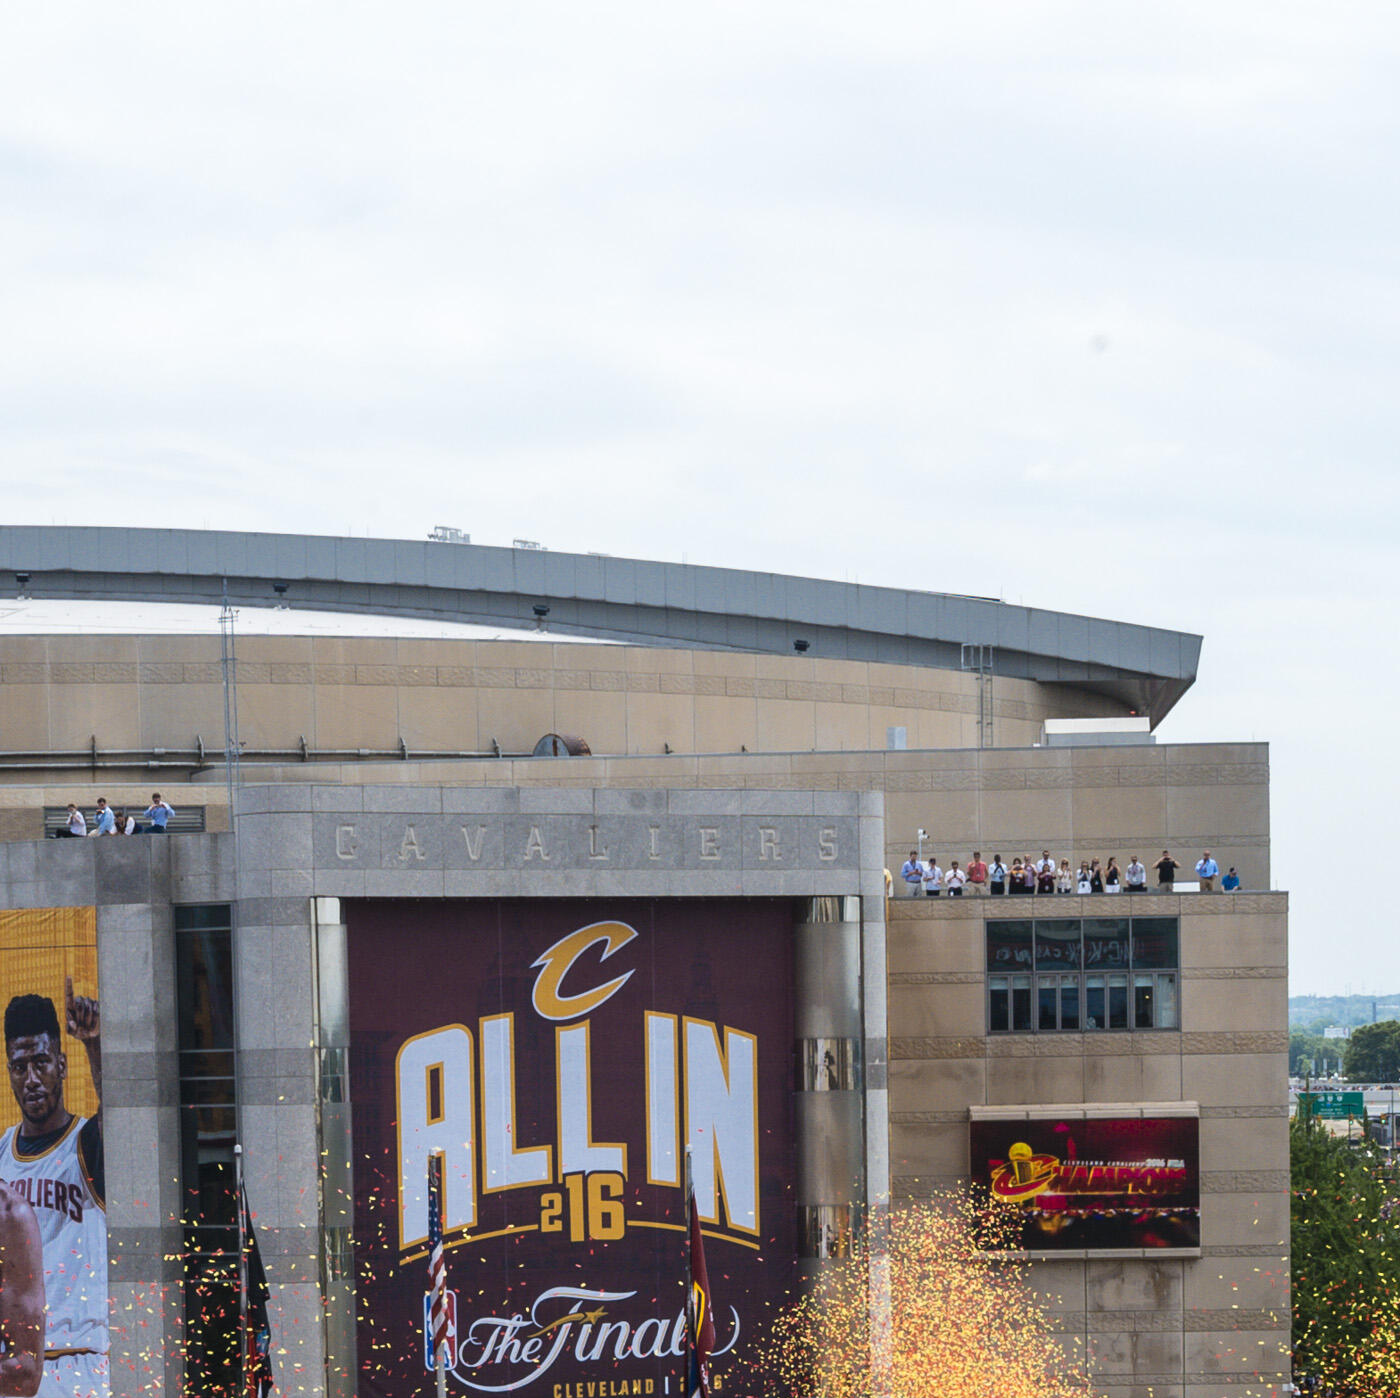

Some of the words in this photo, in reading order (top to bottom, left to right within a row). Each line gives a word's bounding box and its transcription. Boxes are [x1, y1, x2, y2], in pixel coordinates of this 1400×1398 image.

[335, 823, 839, 862] CAVALIERS
[396, 1011, 628, 1251] ALL
[644, 1010, 761, 1237] IN
[540, 1170, 625, 1242] 216
[459, 1313, 542, 1367] The
